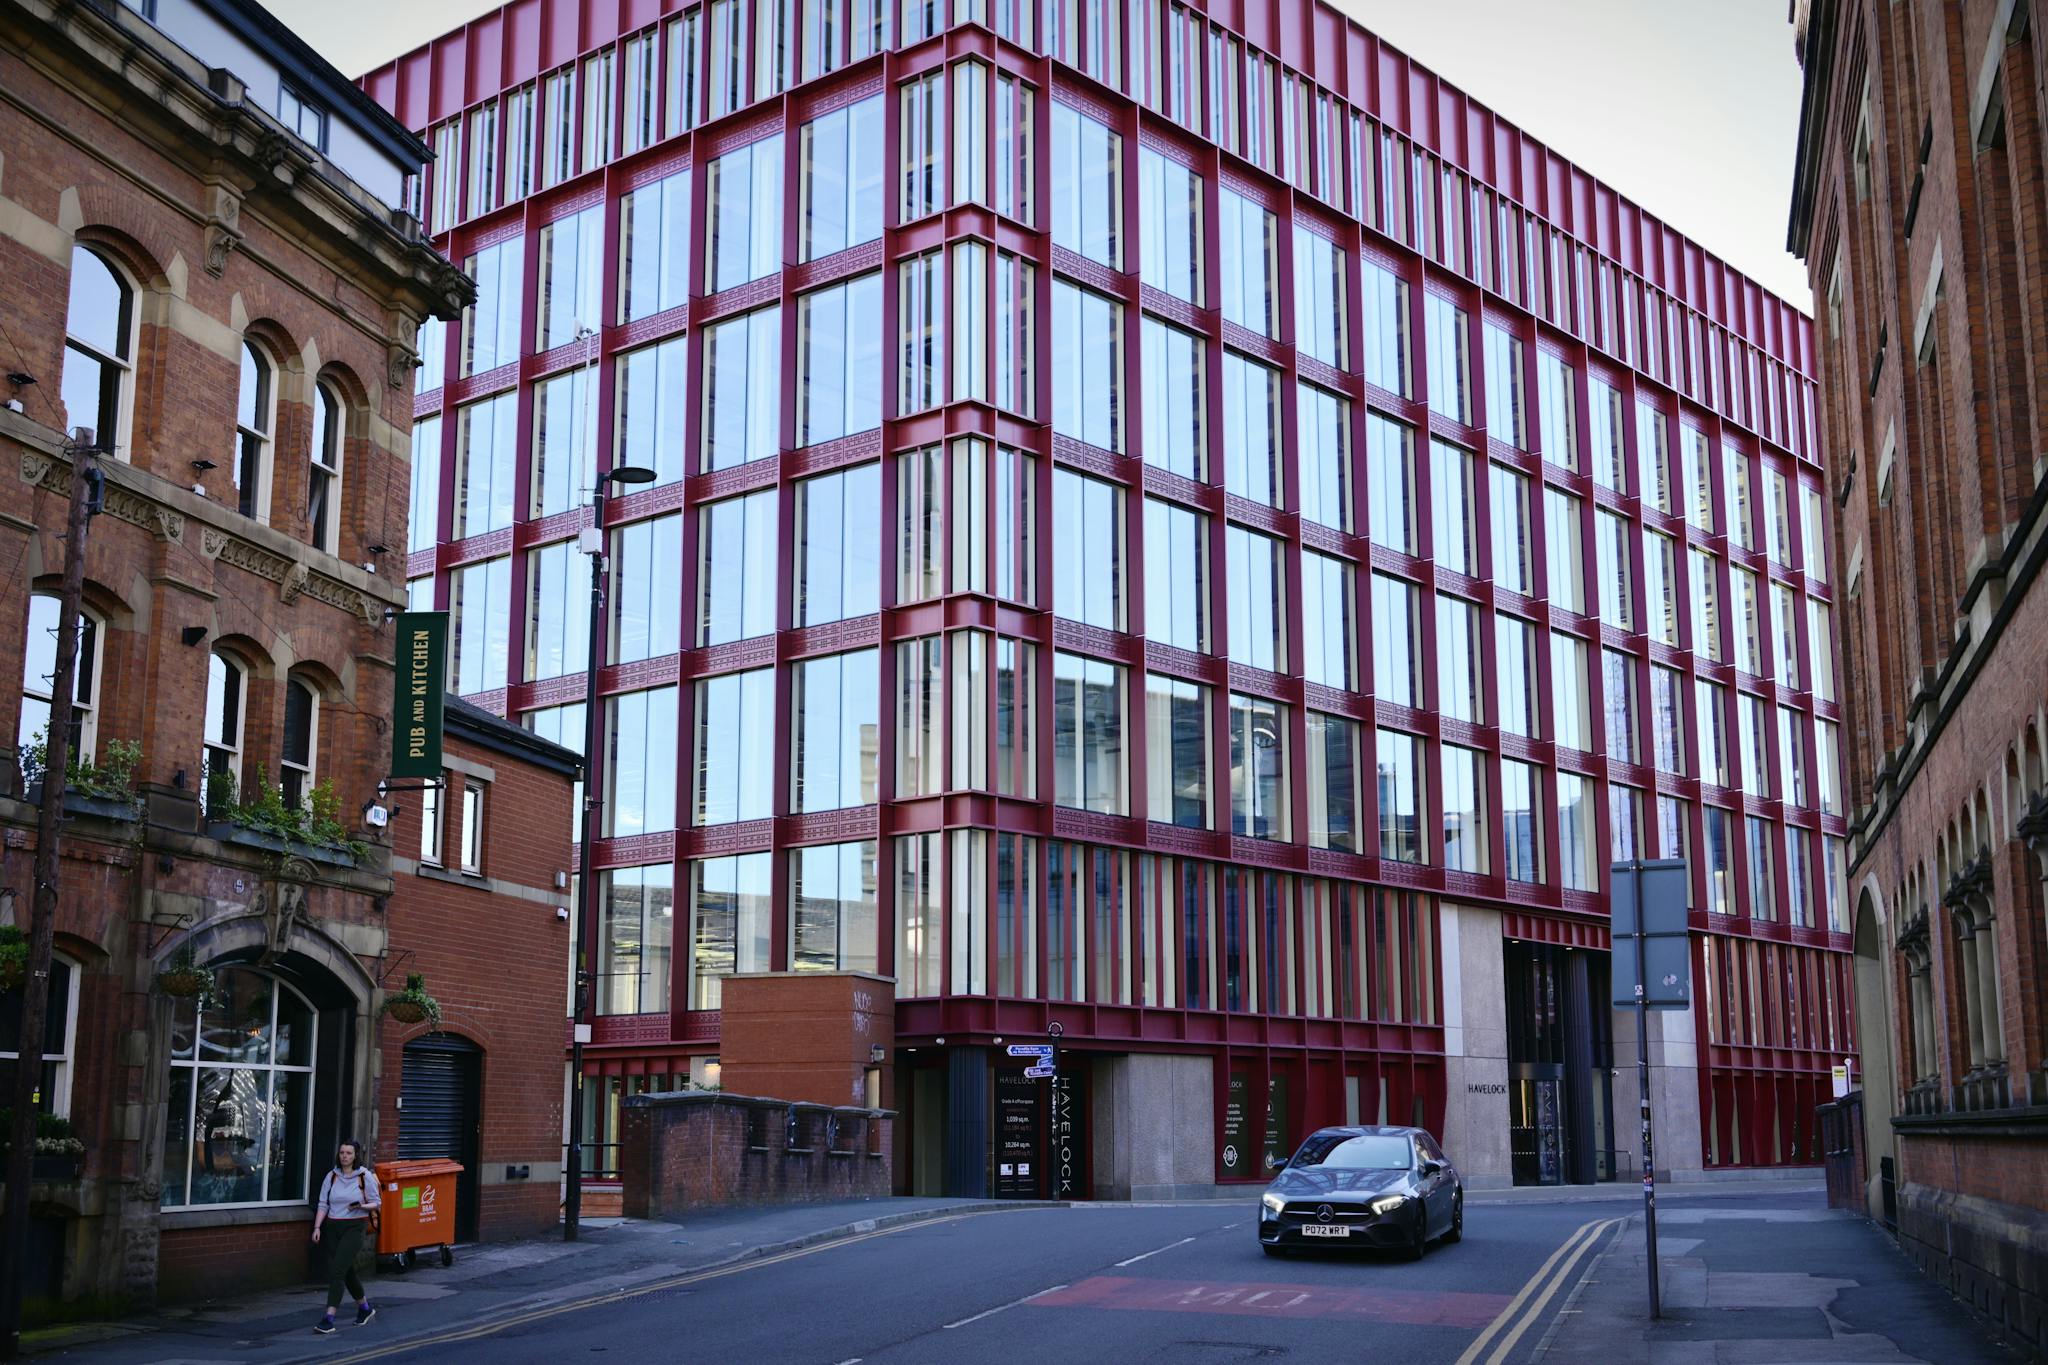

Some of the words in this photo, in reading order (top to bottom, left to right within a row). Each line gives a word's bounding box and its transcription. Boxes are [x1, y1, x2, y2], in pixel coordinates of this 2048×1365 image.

[412, 630, 430, 696] KITCHEN
[413, 699, 425, 723] AND
[410, 727, 426, 758] PUB
[1000, 1076, 1036, 1085] HAVELOCK
[1468, 1083, 1506, 1095] HAVELOCK
[1061, 1077, 1071, 1192] HAVELOCK
